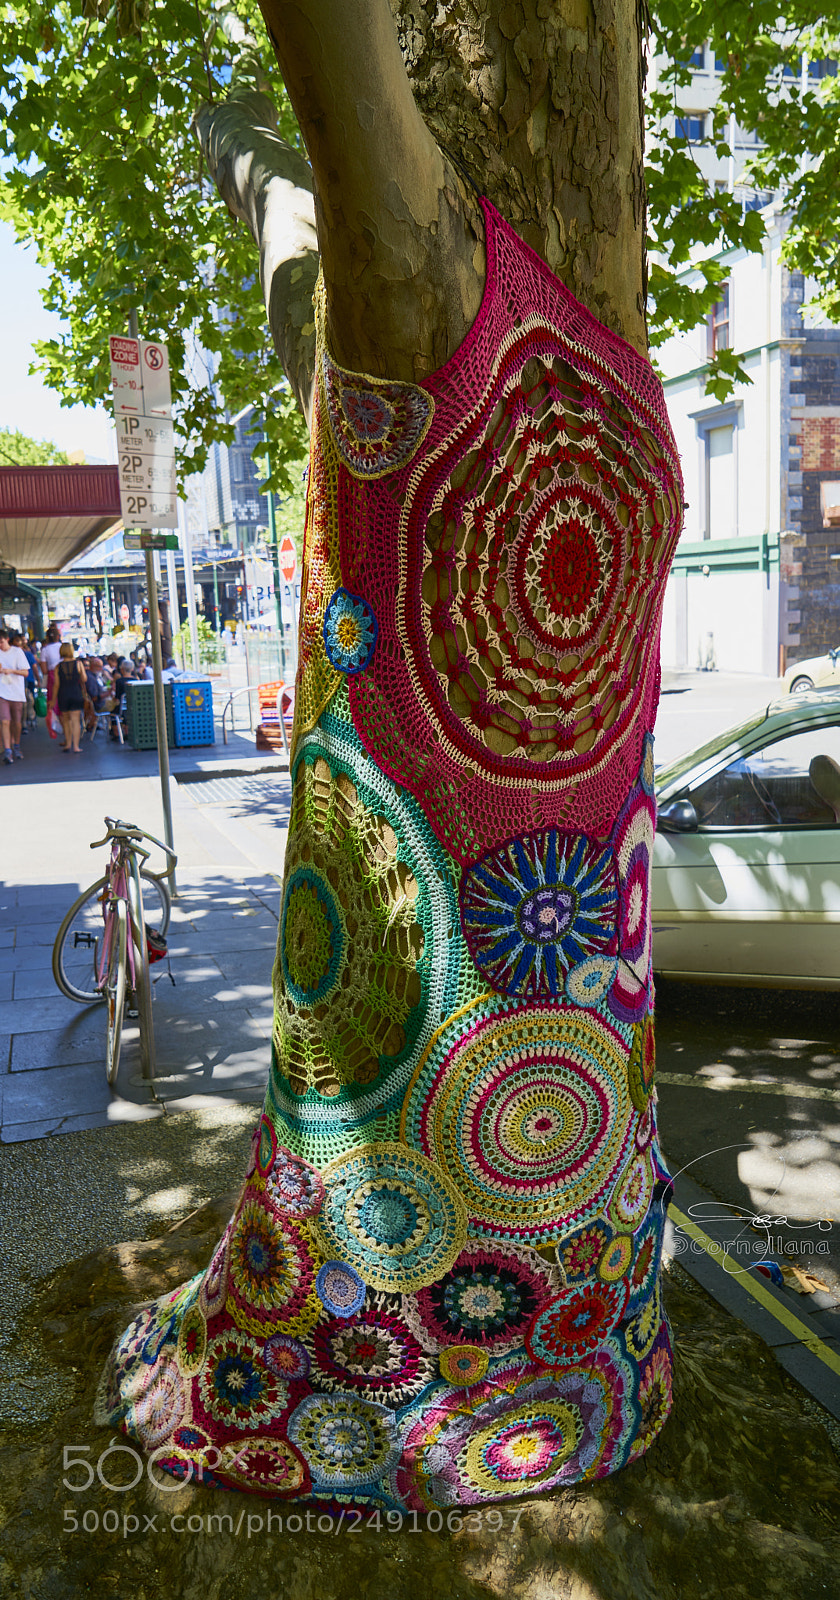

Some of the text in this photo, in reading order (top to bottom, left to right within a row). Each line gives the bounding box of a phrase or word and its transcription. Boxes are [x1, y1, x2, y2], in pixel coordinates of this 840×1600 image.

[112, 340, 138, 353] LOADING
[113, 350, 137, 362] ZONE
[121, 364, 136, 372] HOUR
[121, 417, 140, 435] 1P
[121, 437, 143, 446] METER
[122, 455, 143, 474] 2P
[123, 474, 144, 483] METER
[127, 496, 148, 514] 2P
